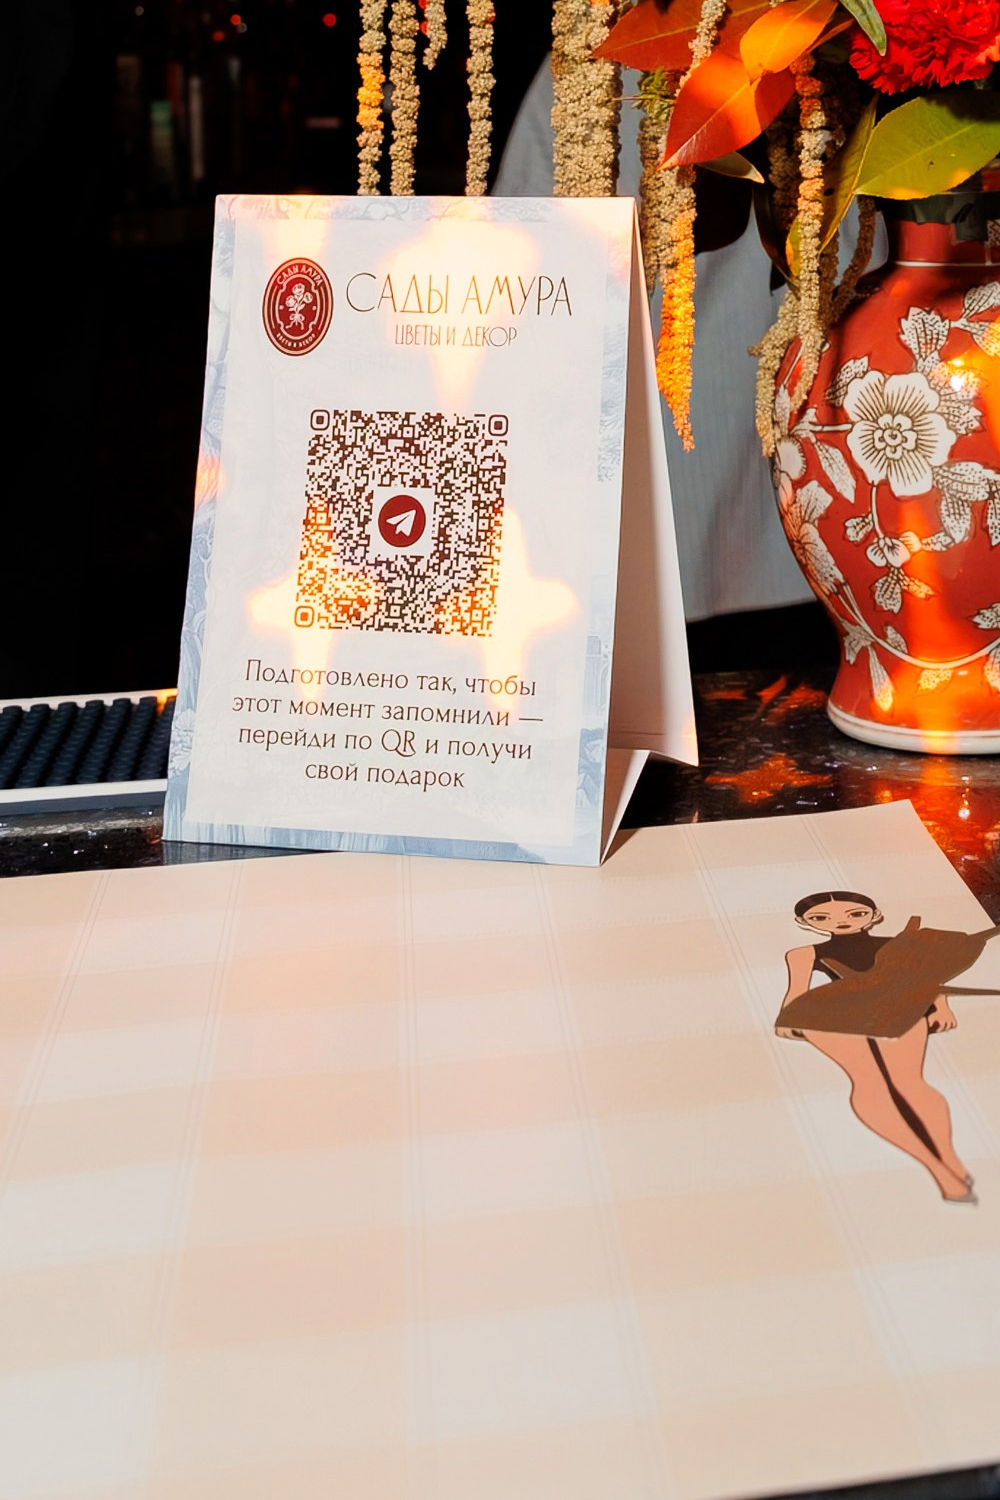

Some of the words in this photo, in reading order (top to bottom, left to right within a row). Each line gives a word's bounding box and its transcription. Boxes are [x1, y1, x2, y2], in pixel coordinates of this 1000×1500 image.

[346, 272, 449, 314] САДЫ
[461, 274, 572, 316] АМУРА
[395, 324, 441, 346] ЦВЕТЫ
[446, 326, 455, 346] И
[461, 326, 517, 347] ДЕКОР
[245, 659, 409, 690] Подготовлено
[416, 674, 457, 695] так,
[465, 675, 536, 696] чтобы
[232, 696, 281, 714] этот
[289, 700, 375, 719] момент
[381, 704, 510, 726] запомнили
[238, 727, 335, 751] перейди
[344, 733, 372, 750] по
[381, 729, 416, 757] QR
[425, 738, 439, 754] и
[448, 739, 532, 763] получи
[305, 763, 358, 782] свой
[367, 766, 464, 792] подарок
